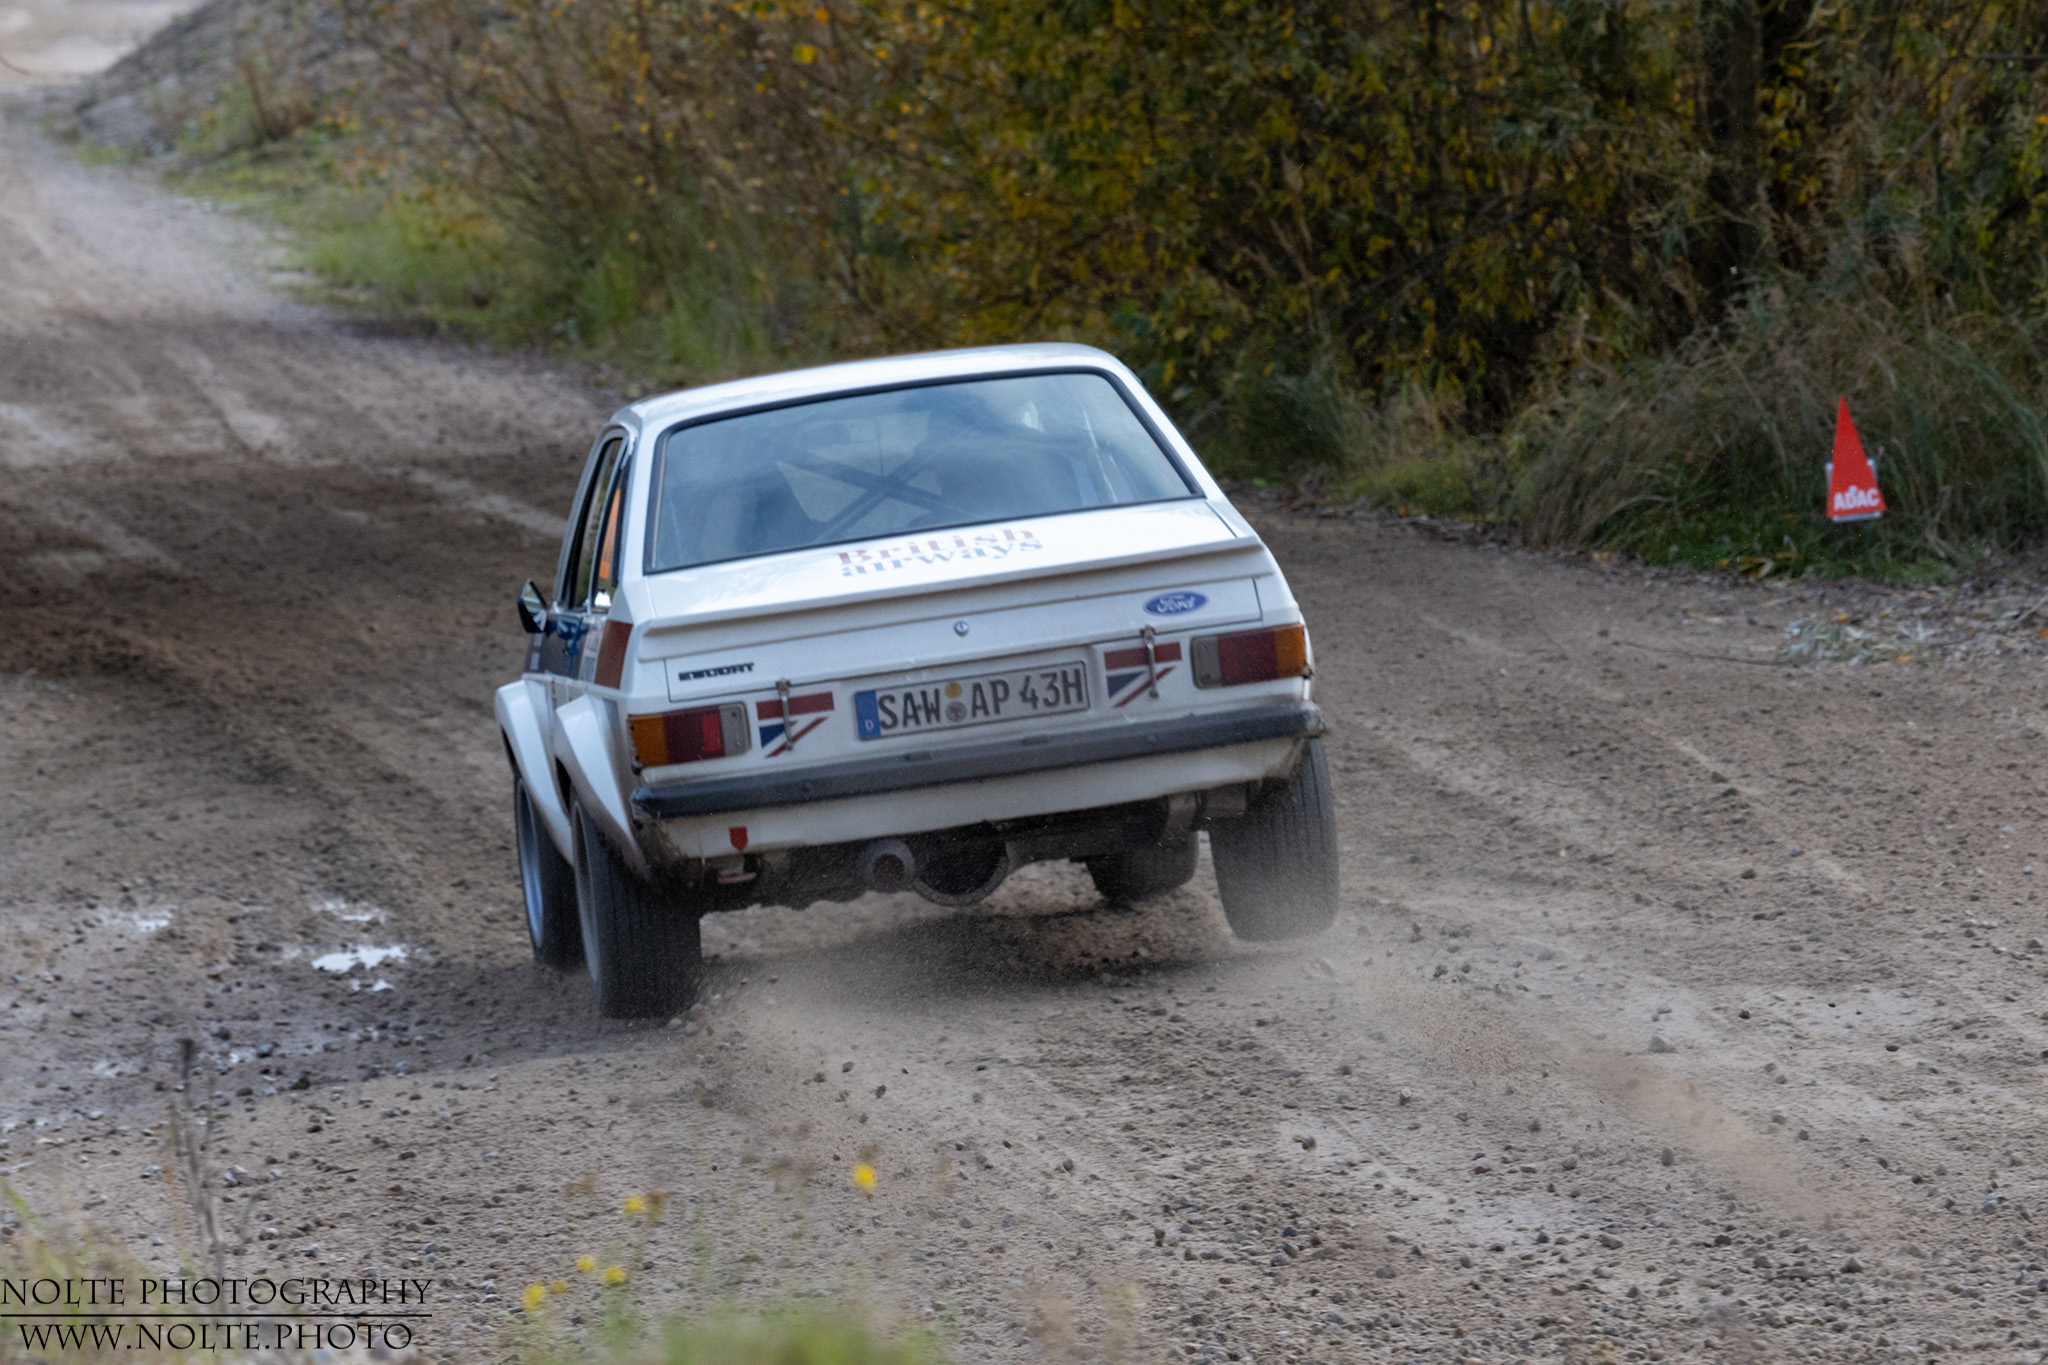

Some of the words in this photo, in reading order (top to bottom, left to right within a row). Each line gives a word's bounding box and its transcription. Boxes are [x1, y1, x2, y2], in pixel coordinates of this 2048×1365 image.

[1833, 489, 1880, 511] ADAC
[838, 528, 1035, 566] British
[841, 539, 1043, 577] airways
[877, 687, 942, 730] SAW
[970, 679, 1010, 718] AP
[1018, 668, 1084, 710] 43H
